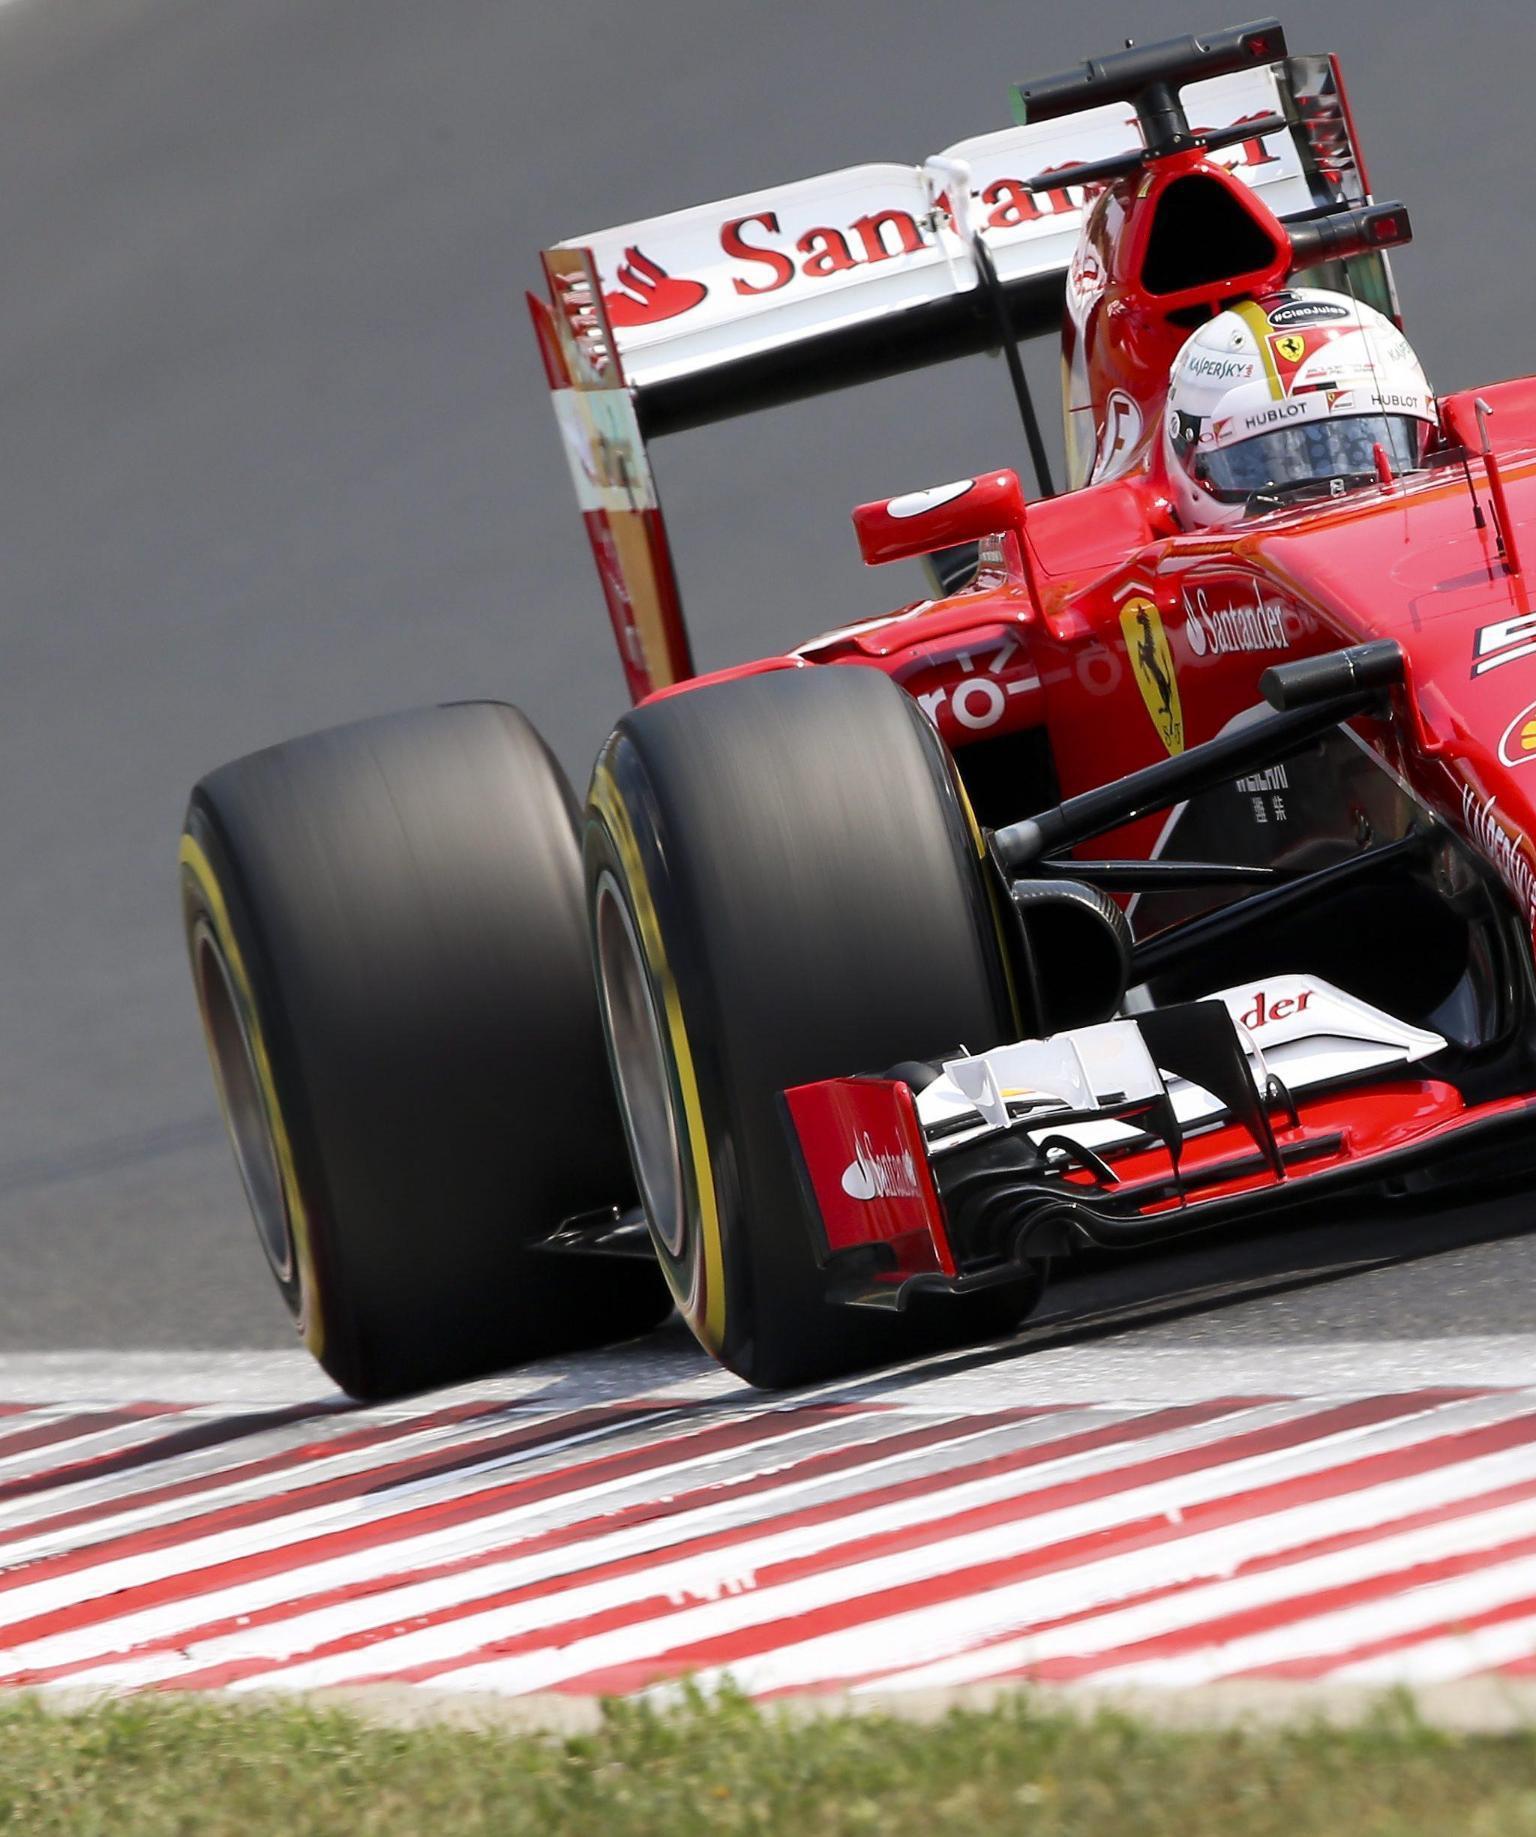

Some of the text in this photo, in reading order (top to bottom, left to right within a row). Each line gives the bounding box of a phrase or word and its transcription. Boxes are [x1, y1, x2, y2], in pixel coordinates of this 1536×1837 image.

[1189, 357, 1246, 379] KASPERSKY
[1371, 394, 1418, 409] HUBLOT
[1246, 402, 1308, 429] HUBLOT
[1197, 577, 1290, 655] Santander
